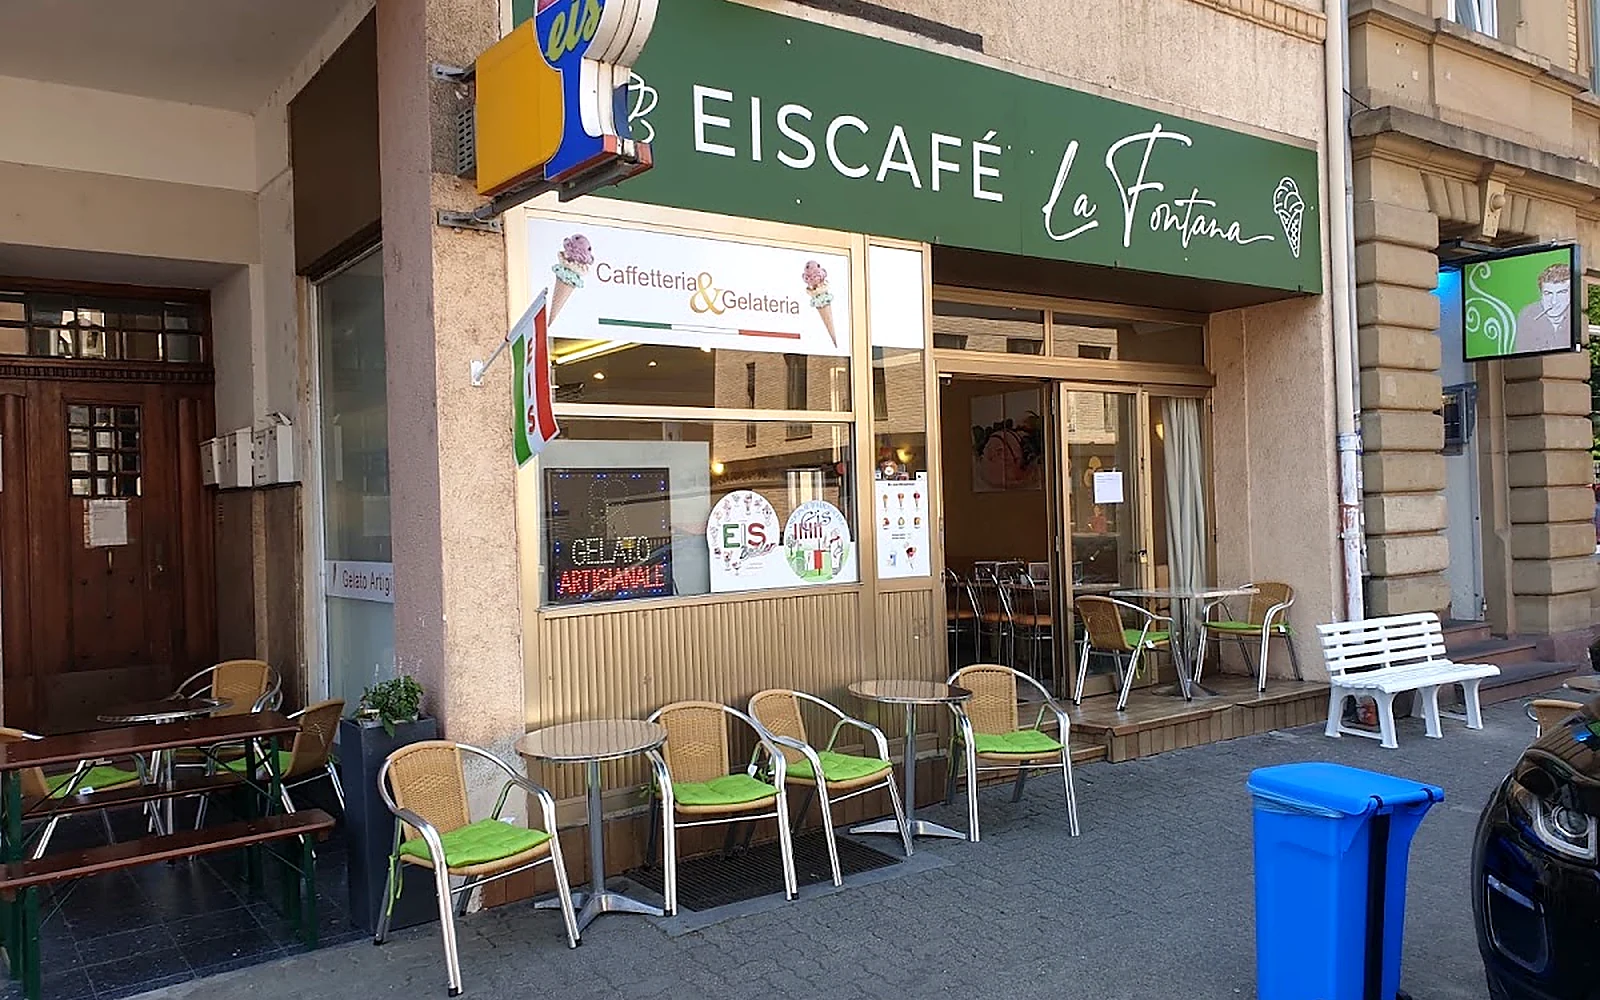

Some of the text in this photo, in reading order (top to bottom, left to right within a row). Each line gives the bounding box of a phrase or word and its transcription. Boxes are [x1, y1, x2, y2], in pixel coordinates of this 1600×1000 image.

[693, 84, 1004, 202] EISCAFÉ
[1042, 123, 1275, 248] La Fontana
[596, 262, 697, 291] Caffetteria
[722, 290, 800, 315] Gelateria
[526, 337, 536, 435] EIS
[571, 536, 651, 566] GELATO
[723, 522, 767, 549] EIS
[342, 569, 368, 590] Gelato
[558, 564, 665, 594] ARTIGIANALE
